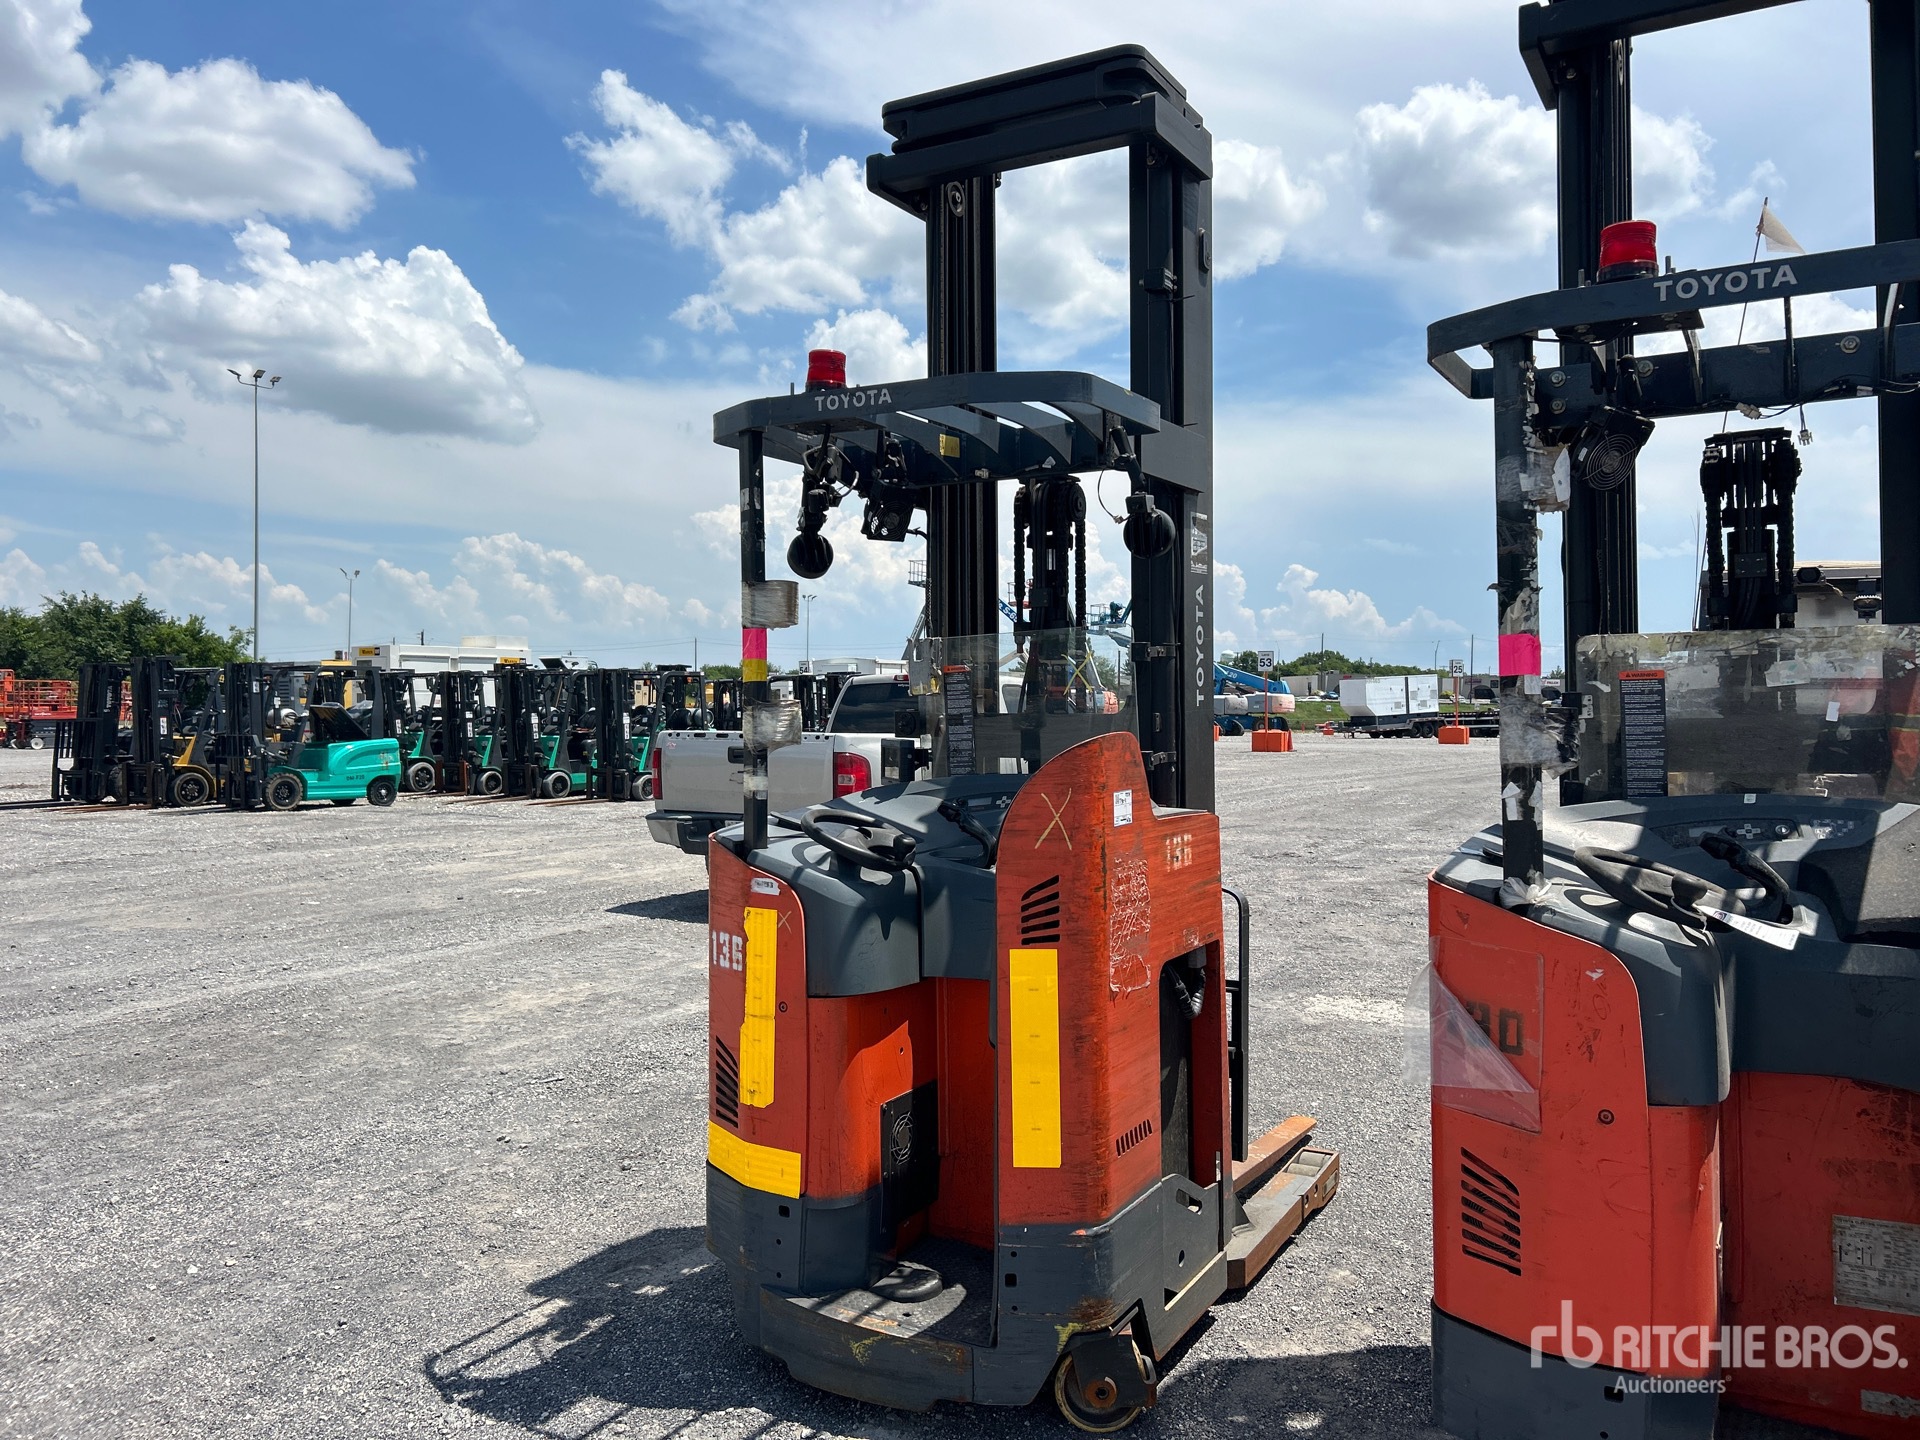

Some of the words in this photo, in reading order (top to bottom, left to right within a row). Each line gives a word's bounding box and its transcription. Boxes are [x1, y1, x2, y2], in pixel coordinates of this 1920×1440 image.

[1653, 264, 1798, 302] TOYOTA
[815, 388, 892, 412] TOYOTA
[1195, 584, 1205, 707] TOYOTA
[799, 666, 808, 675] 54
[1259, 657, 1272, 668] 53
[1453, 664, 1463, 674] 25
[711, 929, 744, 972] 136
